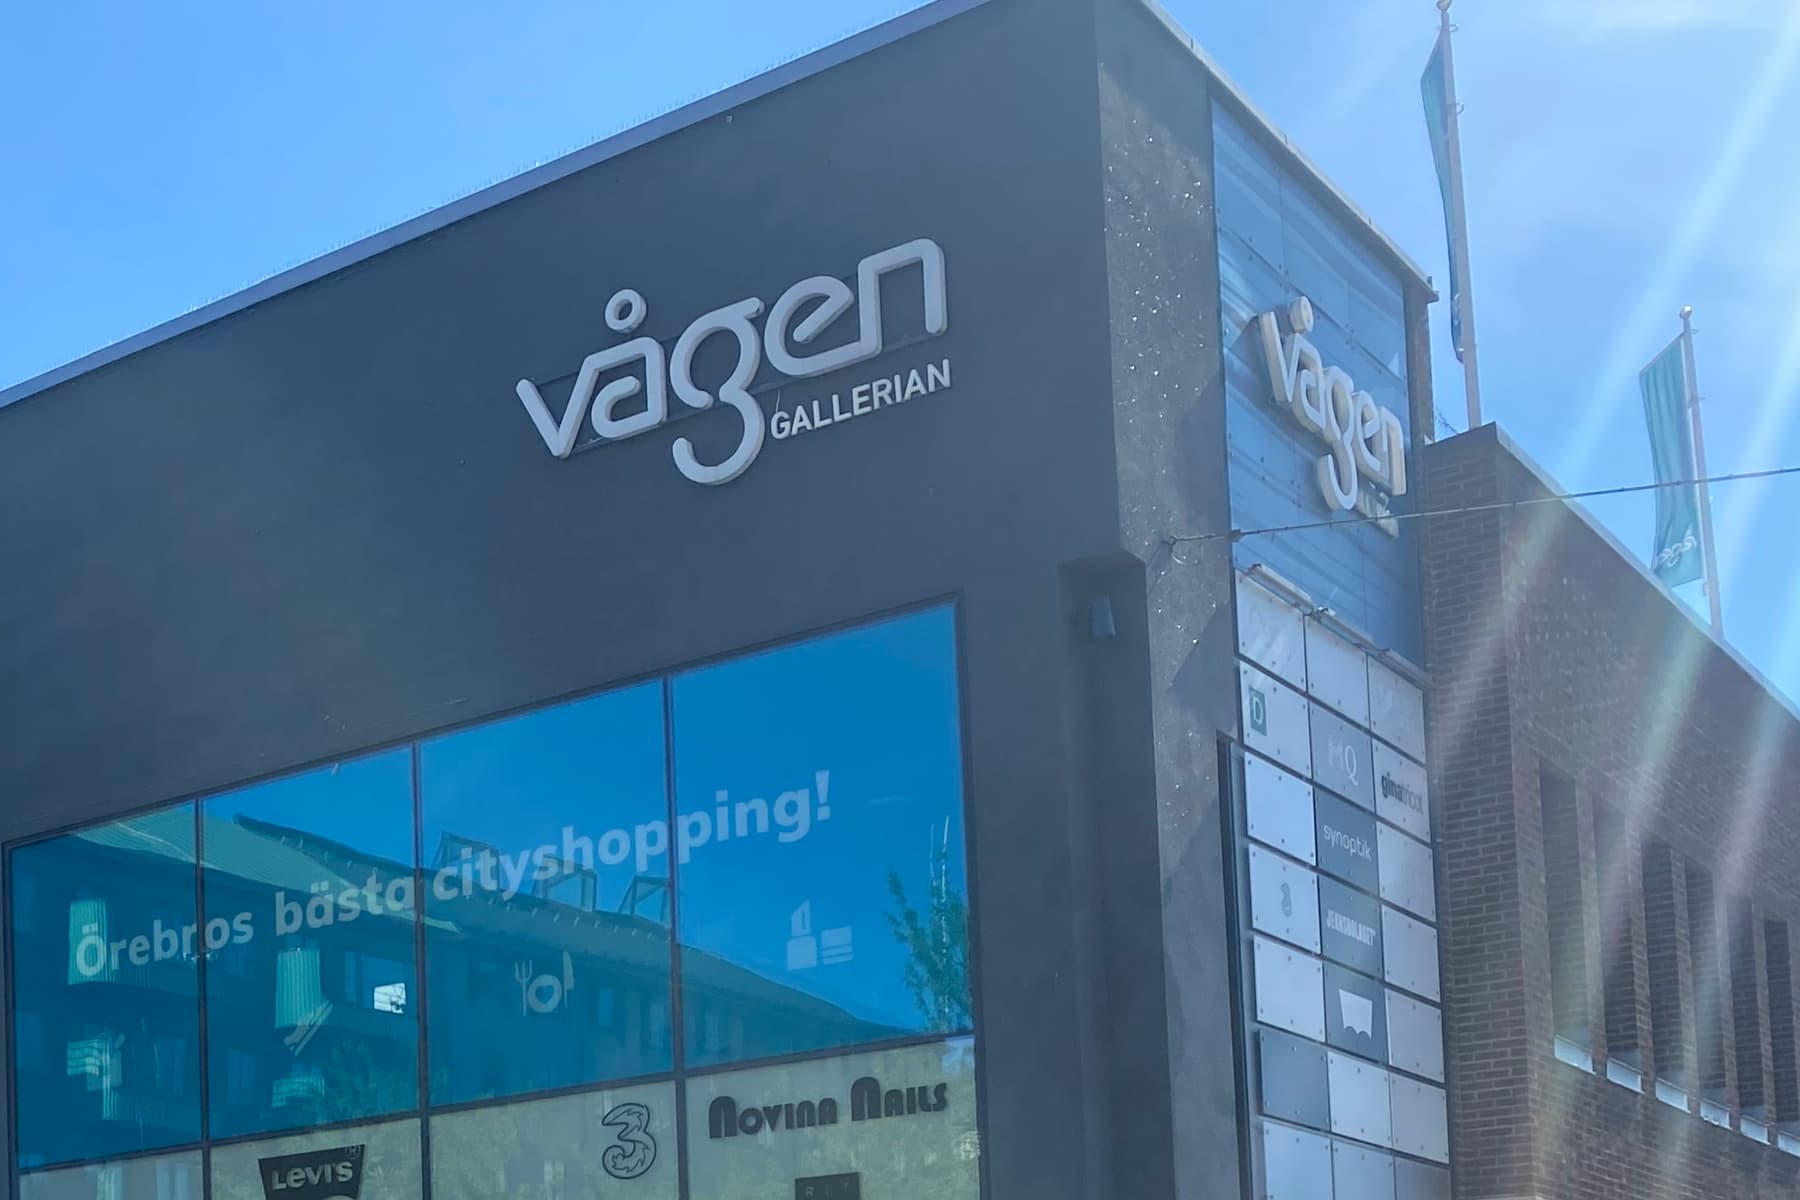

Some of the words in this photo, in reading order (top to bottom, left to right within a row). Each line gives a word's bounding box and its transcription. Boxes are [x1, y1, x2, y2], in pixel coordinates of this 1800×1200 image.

[515, 238, 948, 485] vågen
[770, 359, 952, 440] GALLERIAN
[76, 911, 255, 977] Örebros
[274, 876, 416, 937] bästa
[432, 769, 831, 901] cityshopping!
